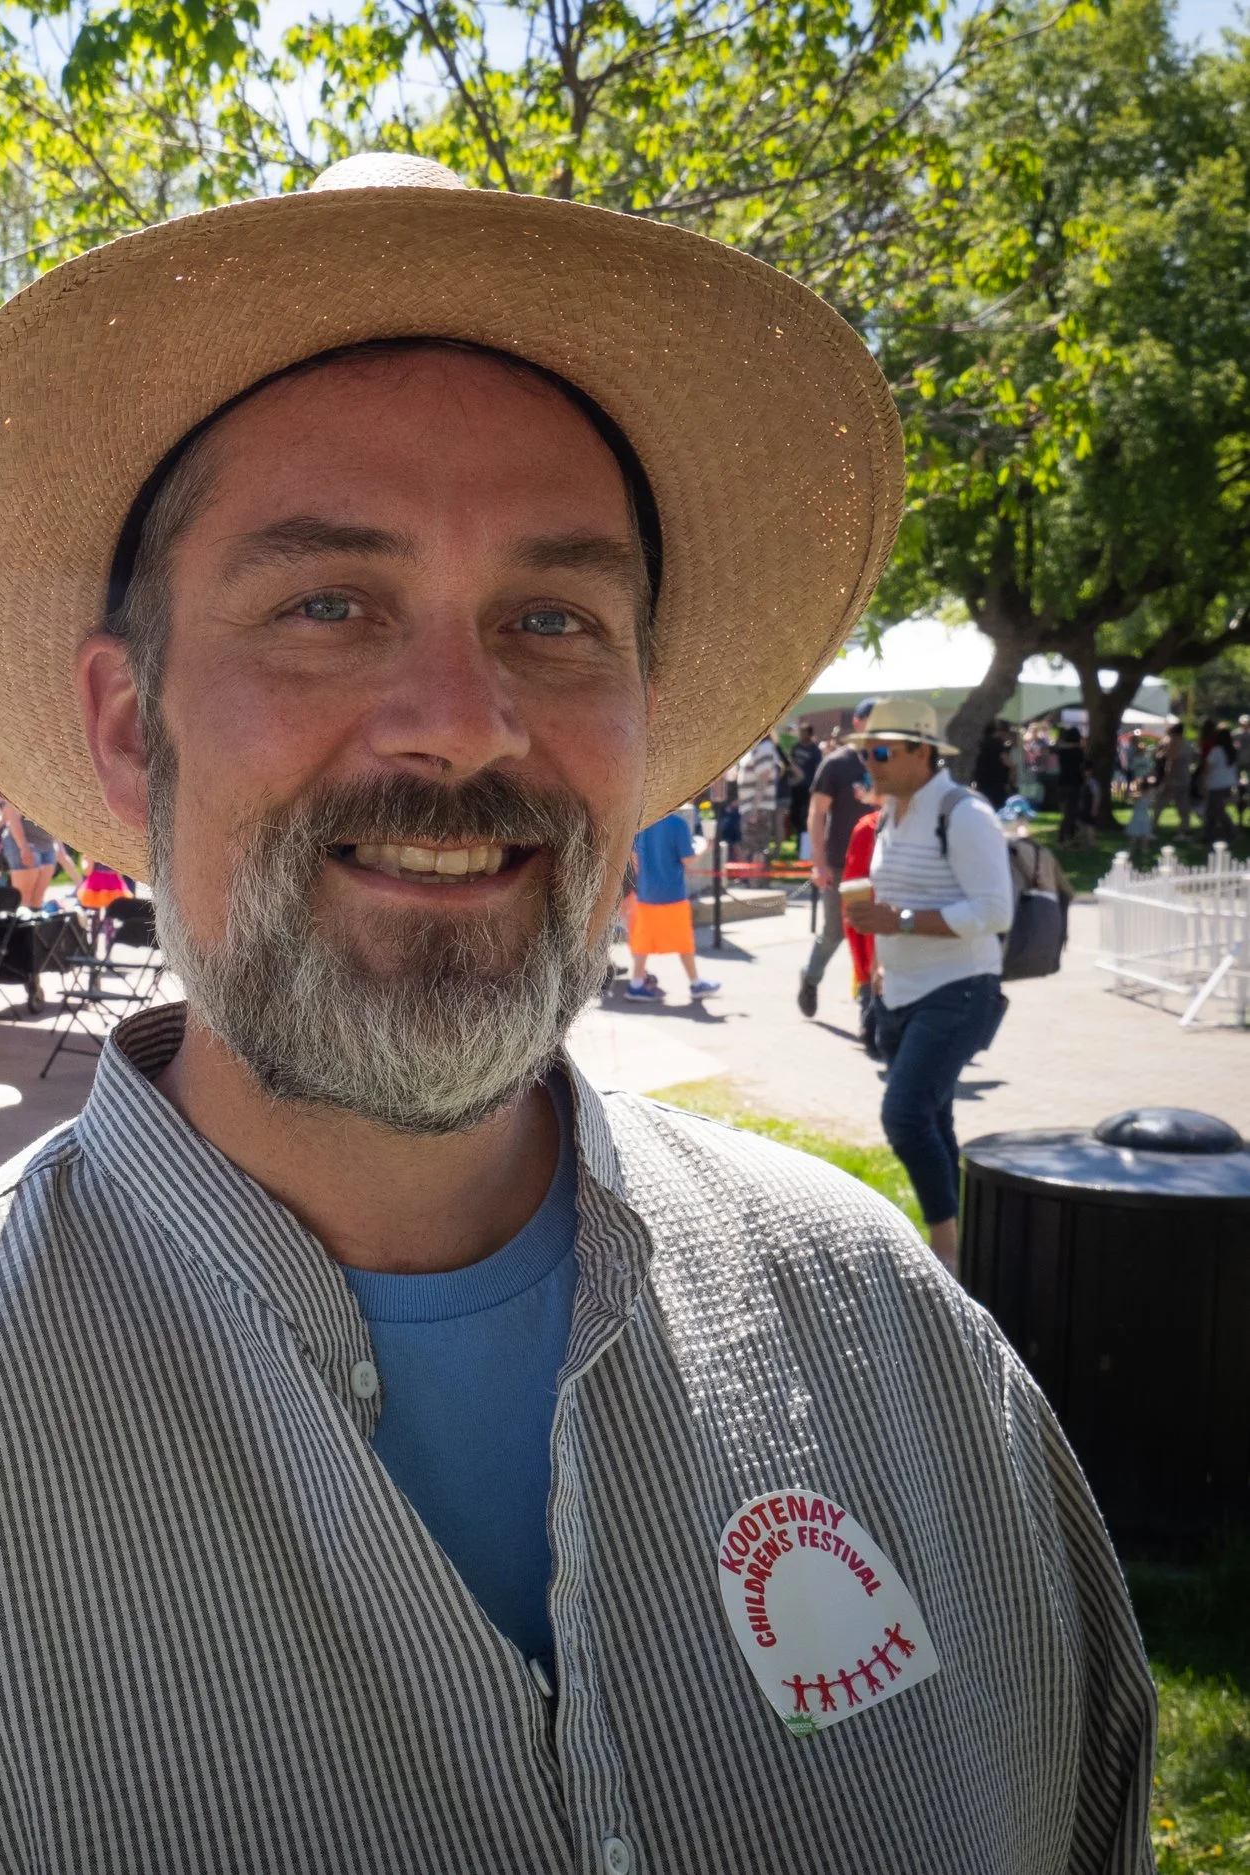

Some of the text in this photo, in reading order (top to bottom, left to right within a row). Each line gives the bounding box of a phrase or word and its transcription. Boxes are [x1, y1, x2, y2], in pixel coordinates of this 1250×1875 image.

[719, 1495, 846, 1576] KOOTENAY
[744, 1526, 882, 1648] CHILDREN'S FESTIVAL
